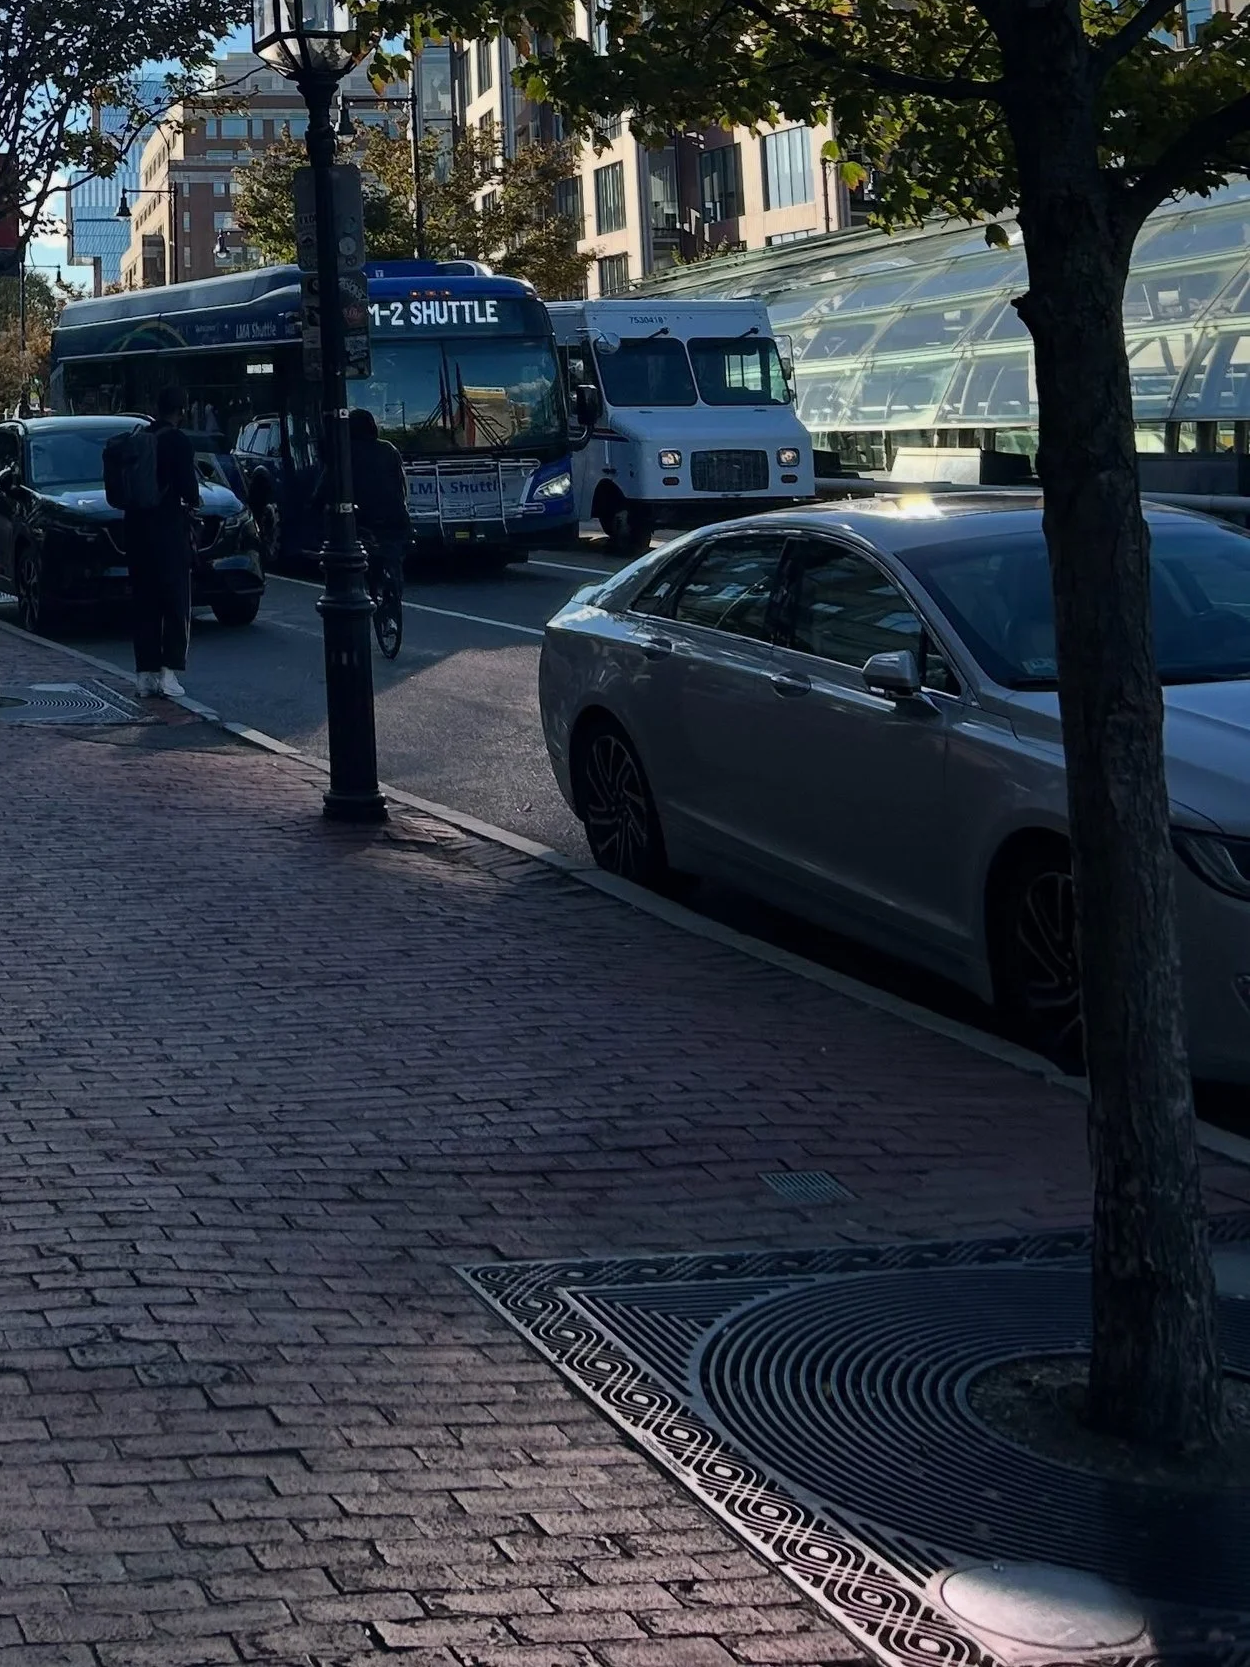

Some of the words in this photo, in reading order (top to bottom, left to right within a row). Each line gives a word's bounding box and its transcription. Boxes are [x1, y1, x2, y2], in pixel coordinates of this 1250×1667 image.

[409, 300, 499, 325] SHUTTLE
[236, 324, 250, 339] LMA
[252, 320, 277, 338] Shuttle
[410, 482, 446, 495] LMA
